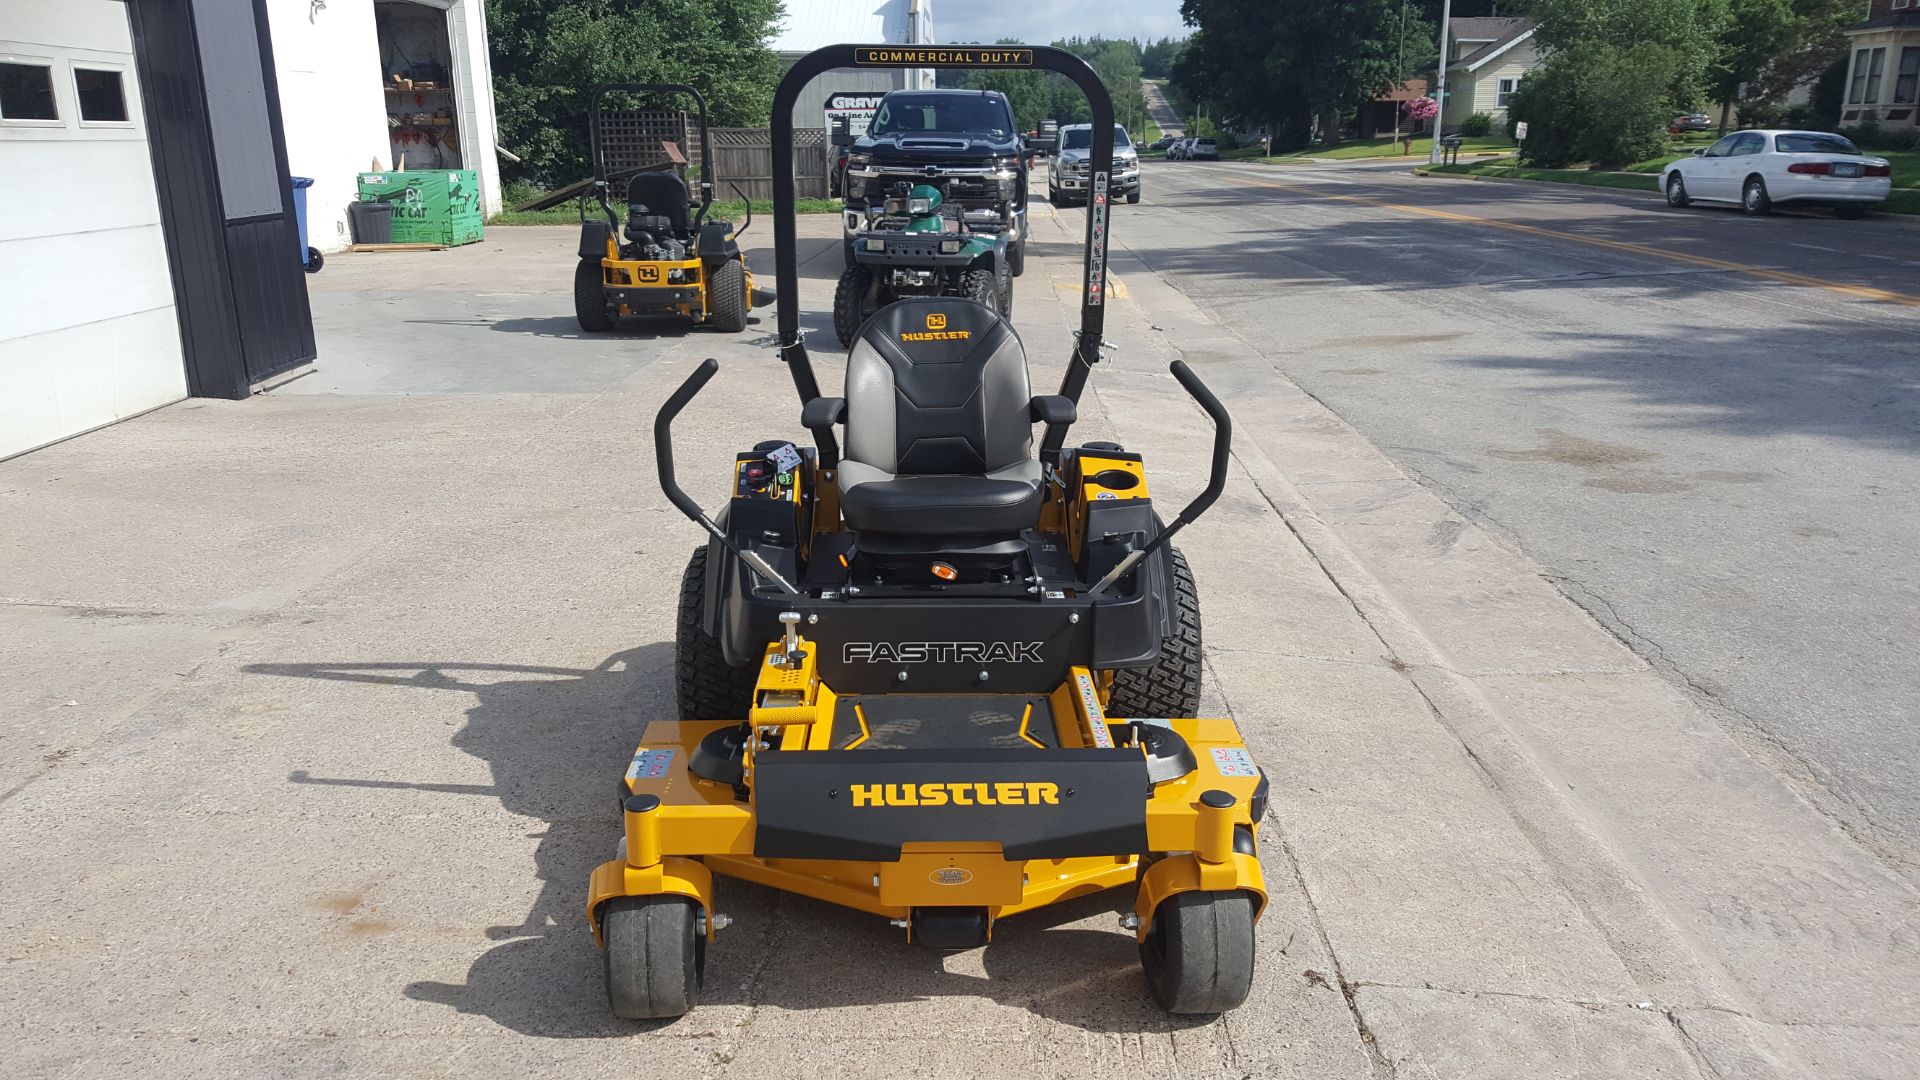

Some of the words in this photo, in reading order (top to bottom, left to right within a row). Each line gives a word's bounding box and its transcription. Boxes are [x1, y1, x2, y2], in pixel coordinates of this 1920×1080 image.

[869, 51, 973, 62] COMMERCIAL
[981, 52, 1021, 62] DUTY
[391, 206, 405, 218] TIC
[901, 331, 969, 341] HUSTLER
[843, 641, 1044, 663] FASTRAK
[850, 782, 1059, 807] HUSTLER
